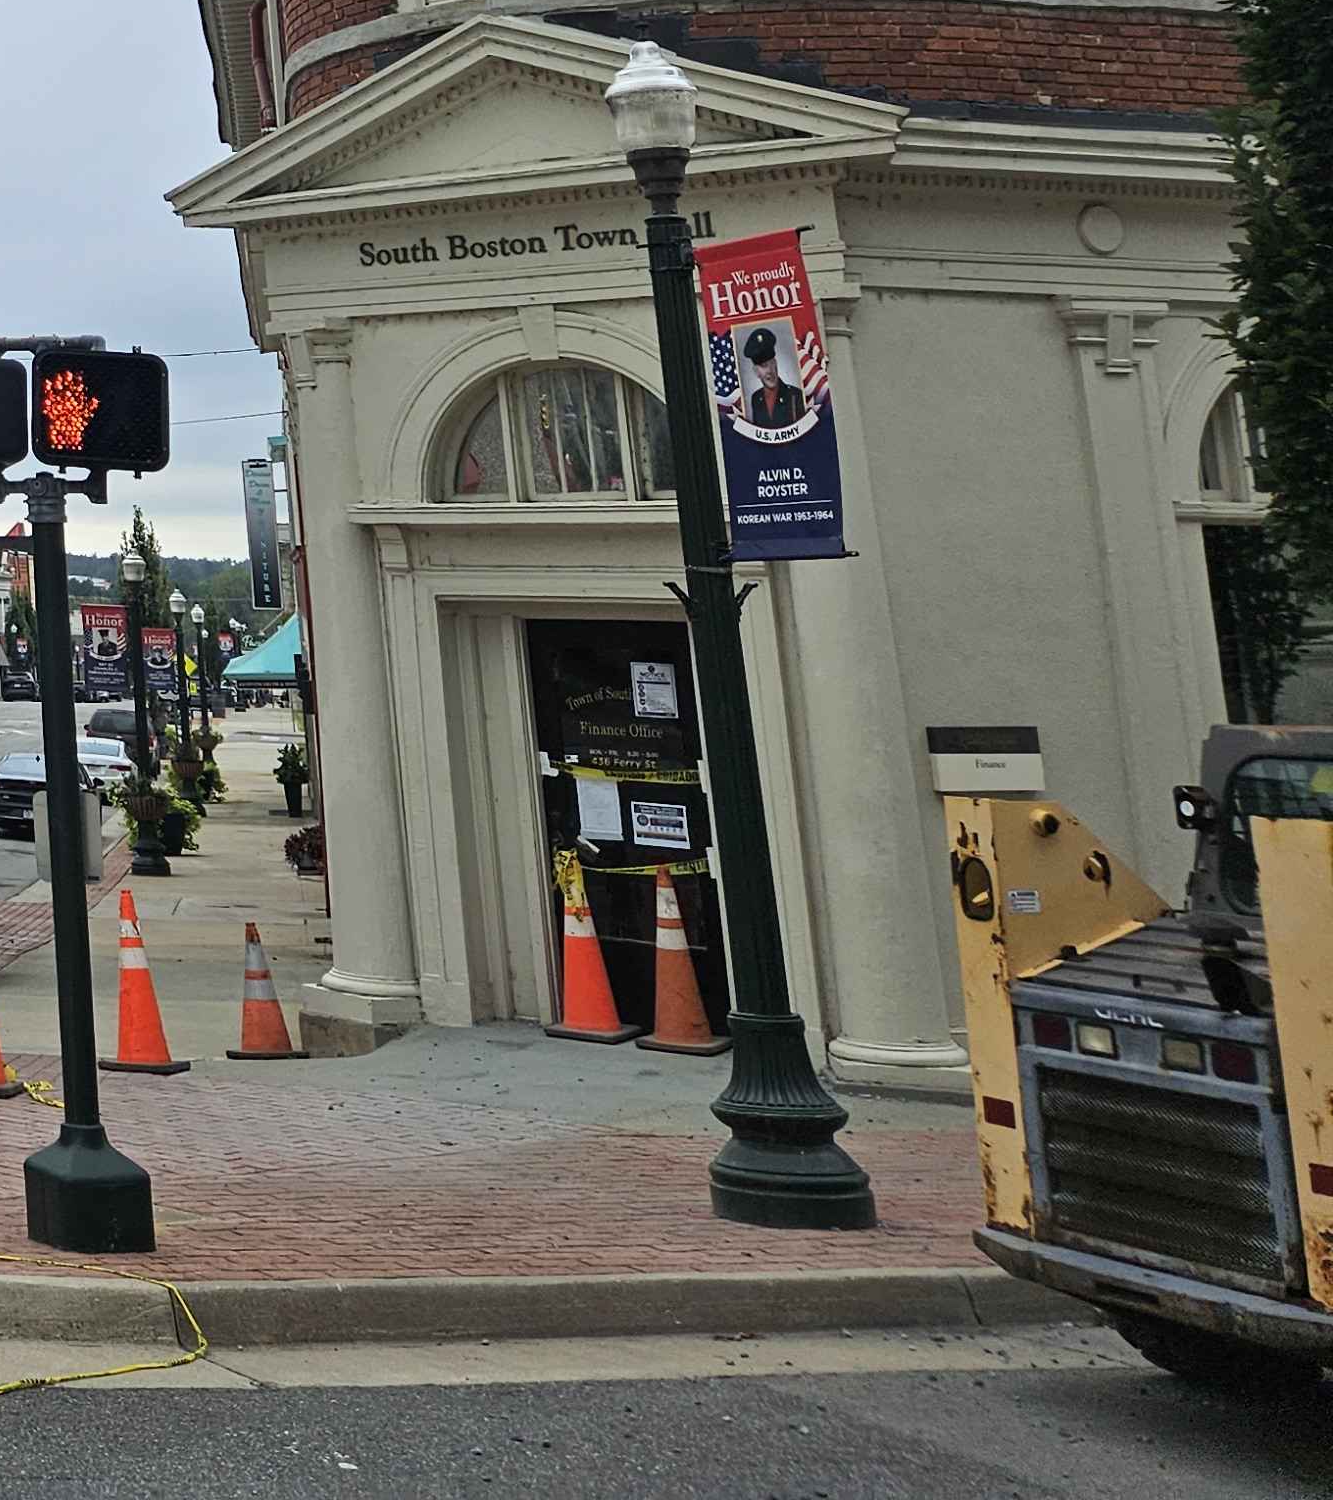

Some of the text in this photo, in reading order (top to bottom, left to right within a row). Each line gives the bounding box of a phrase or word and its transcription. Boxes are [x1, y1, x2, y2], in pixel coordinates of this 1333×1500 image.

[359, 237, 439, 267] South
[446, 234, 548, 261] Boston
[553, 223, 639, 251] Town
[731, 261, 797, 290] We proudly
[708, 280, 803, 319] Honor
[755, 427, 801, 442] U.S. ARMY
[758, 467, 806, 483] ALVIN D.
[758, 482, 808, 499] ROYSTER
[737, 512, 771, 525] KOREAN
[772, 511, 792, 524] WAR
[85, 614, 124, 627] Honor
[580, 720, 664, 740] Finance Office
[614, 759, 641, 769] Ferry
